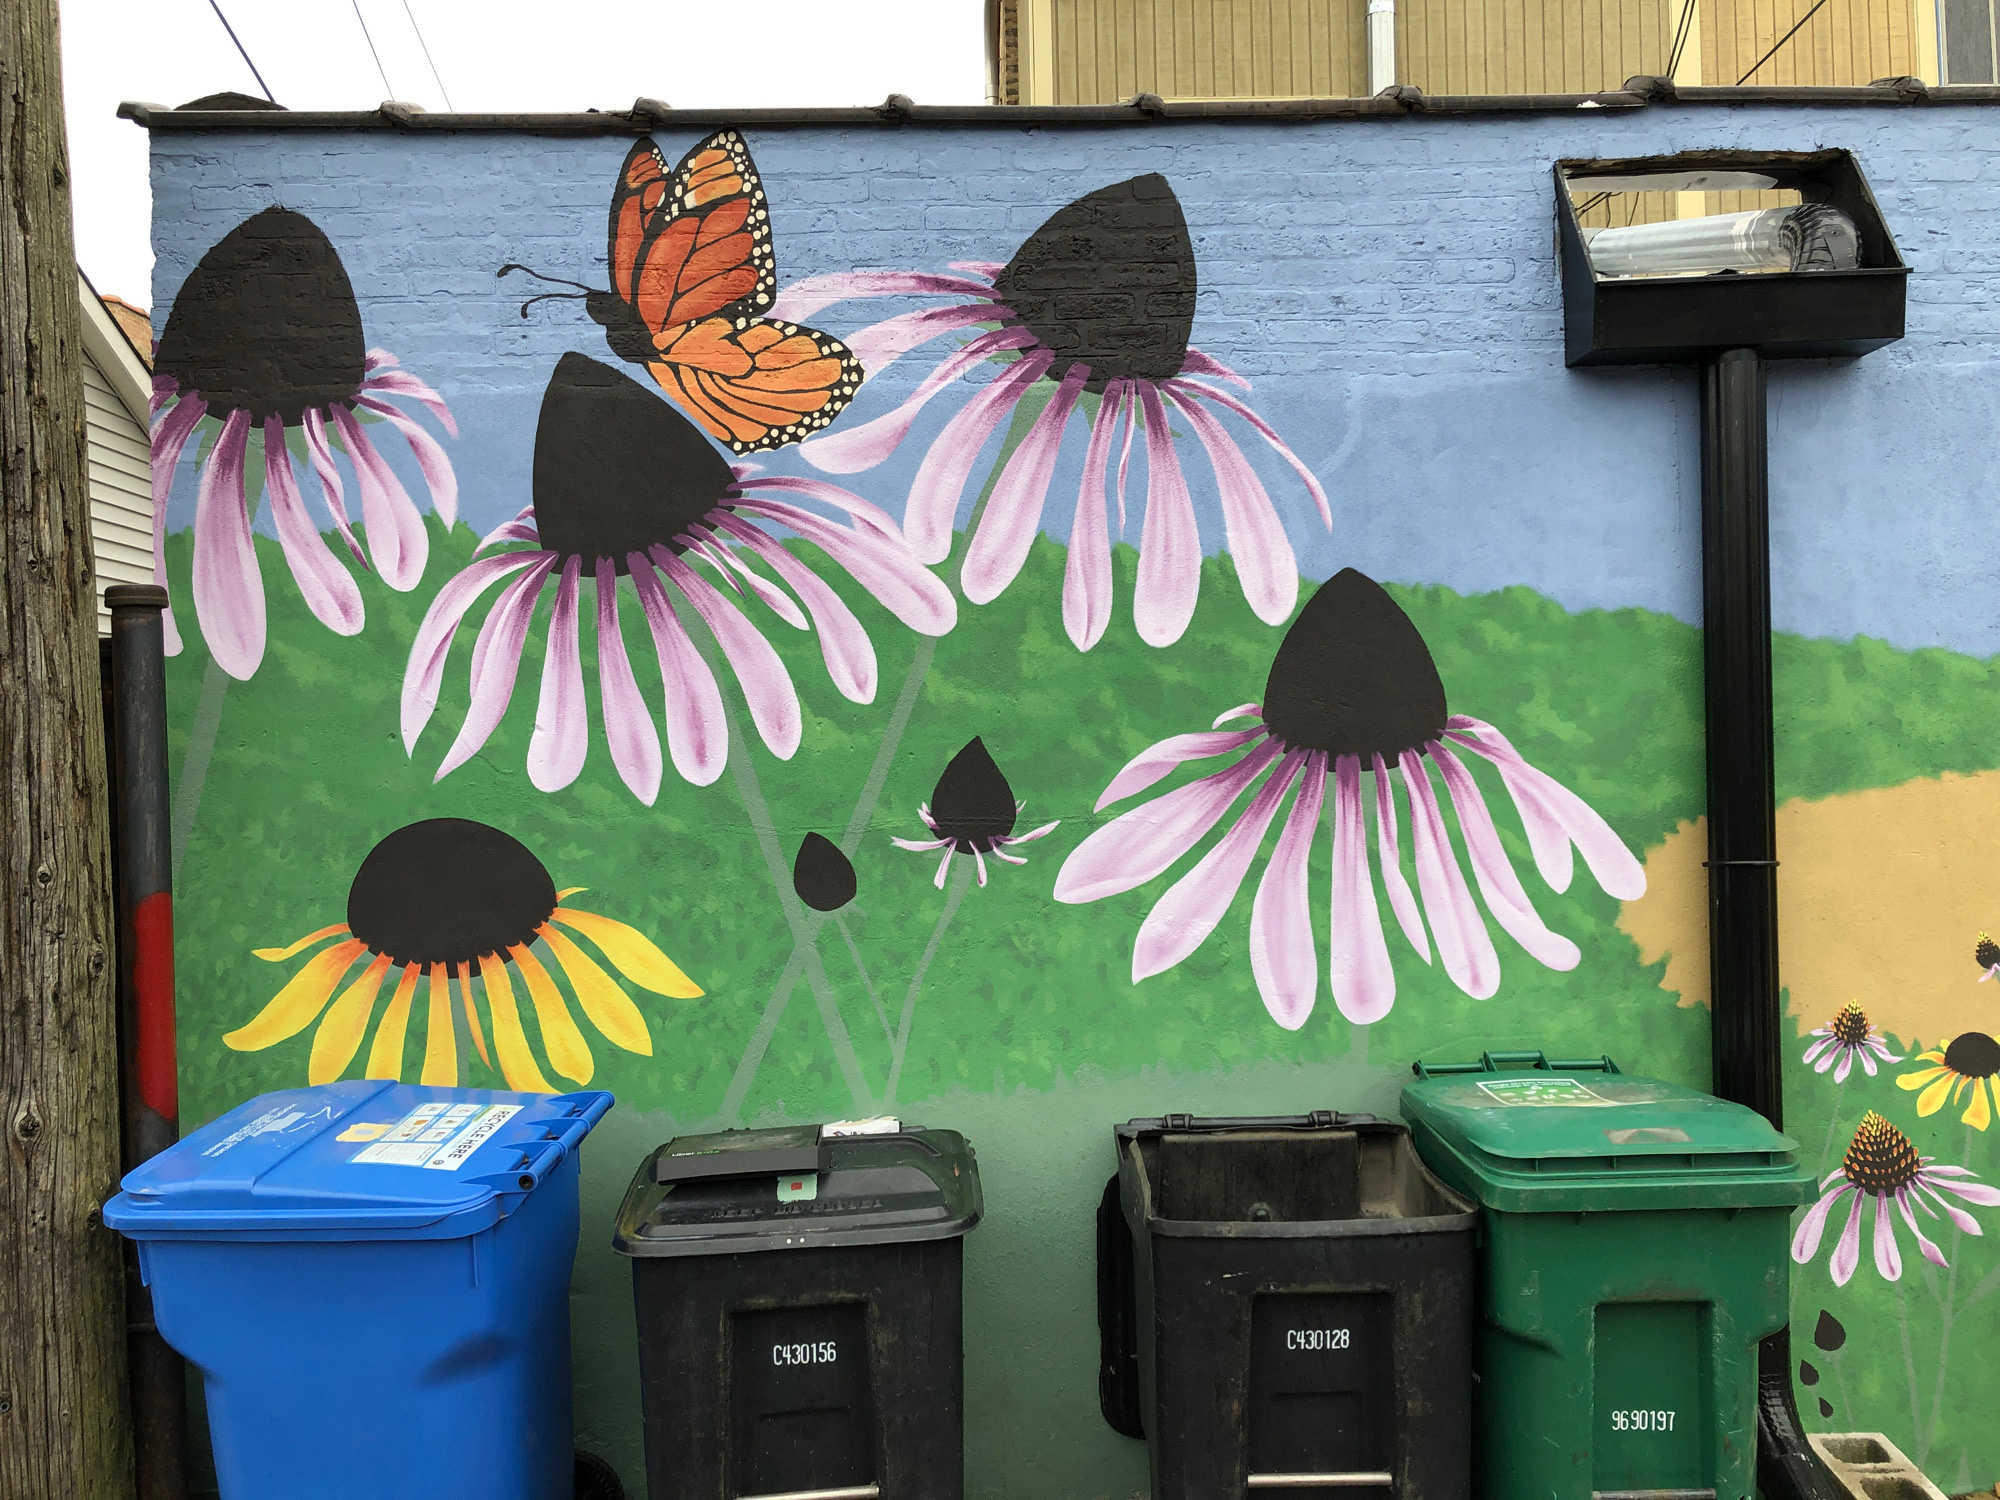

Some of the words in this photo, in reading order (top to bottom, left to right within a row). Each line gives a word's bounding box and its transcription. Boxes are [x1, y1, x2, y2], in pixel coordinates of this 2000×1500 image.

[470, 1110, 511, 1138] RECYCLE
[447, 1138, 477, 1159] HERE
[1287, 1328, 1350, 1350] C430128
[773, 1341, 837, 1366] C430156
[1611, 1409, 1676, 1432] 9690197
